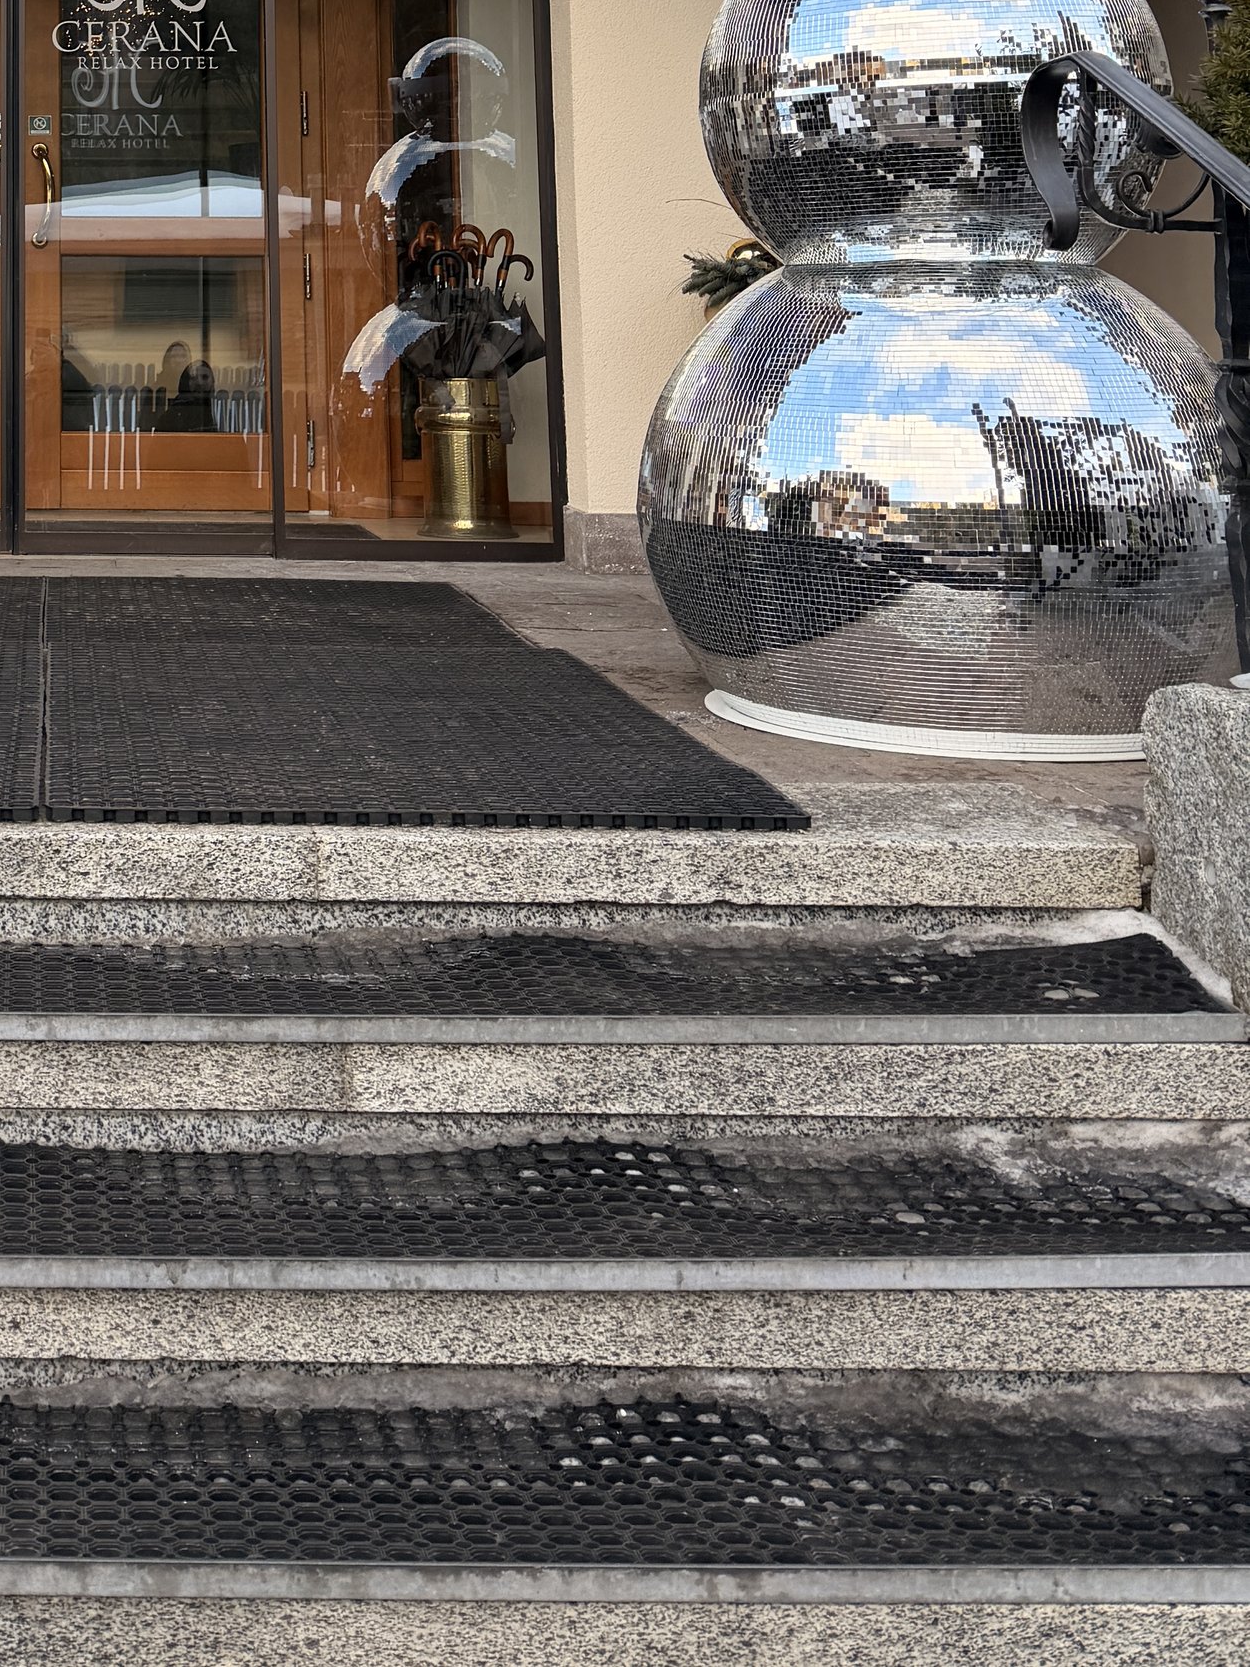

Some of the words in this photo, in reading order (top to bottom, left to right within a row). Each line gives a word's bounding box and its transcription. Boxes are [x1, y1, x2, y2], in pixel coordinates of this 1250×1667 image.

[52, 20, 238, 53] CERANA
[77, 56, 143, 70] RELAX
[150, 56, 219, 70] HOTEL
[61, 113, 184, 137] CERANA
[71, 138, 117, 149] RELAX
[122, 138, 170, 149] HOTEL
